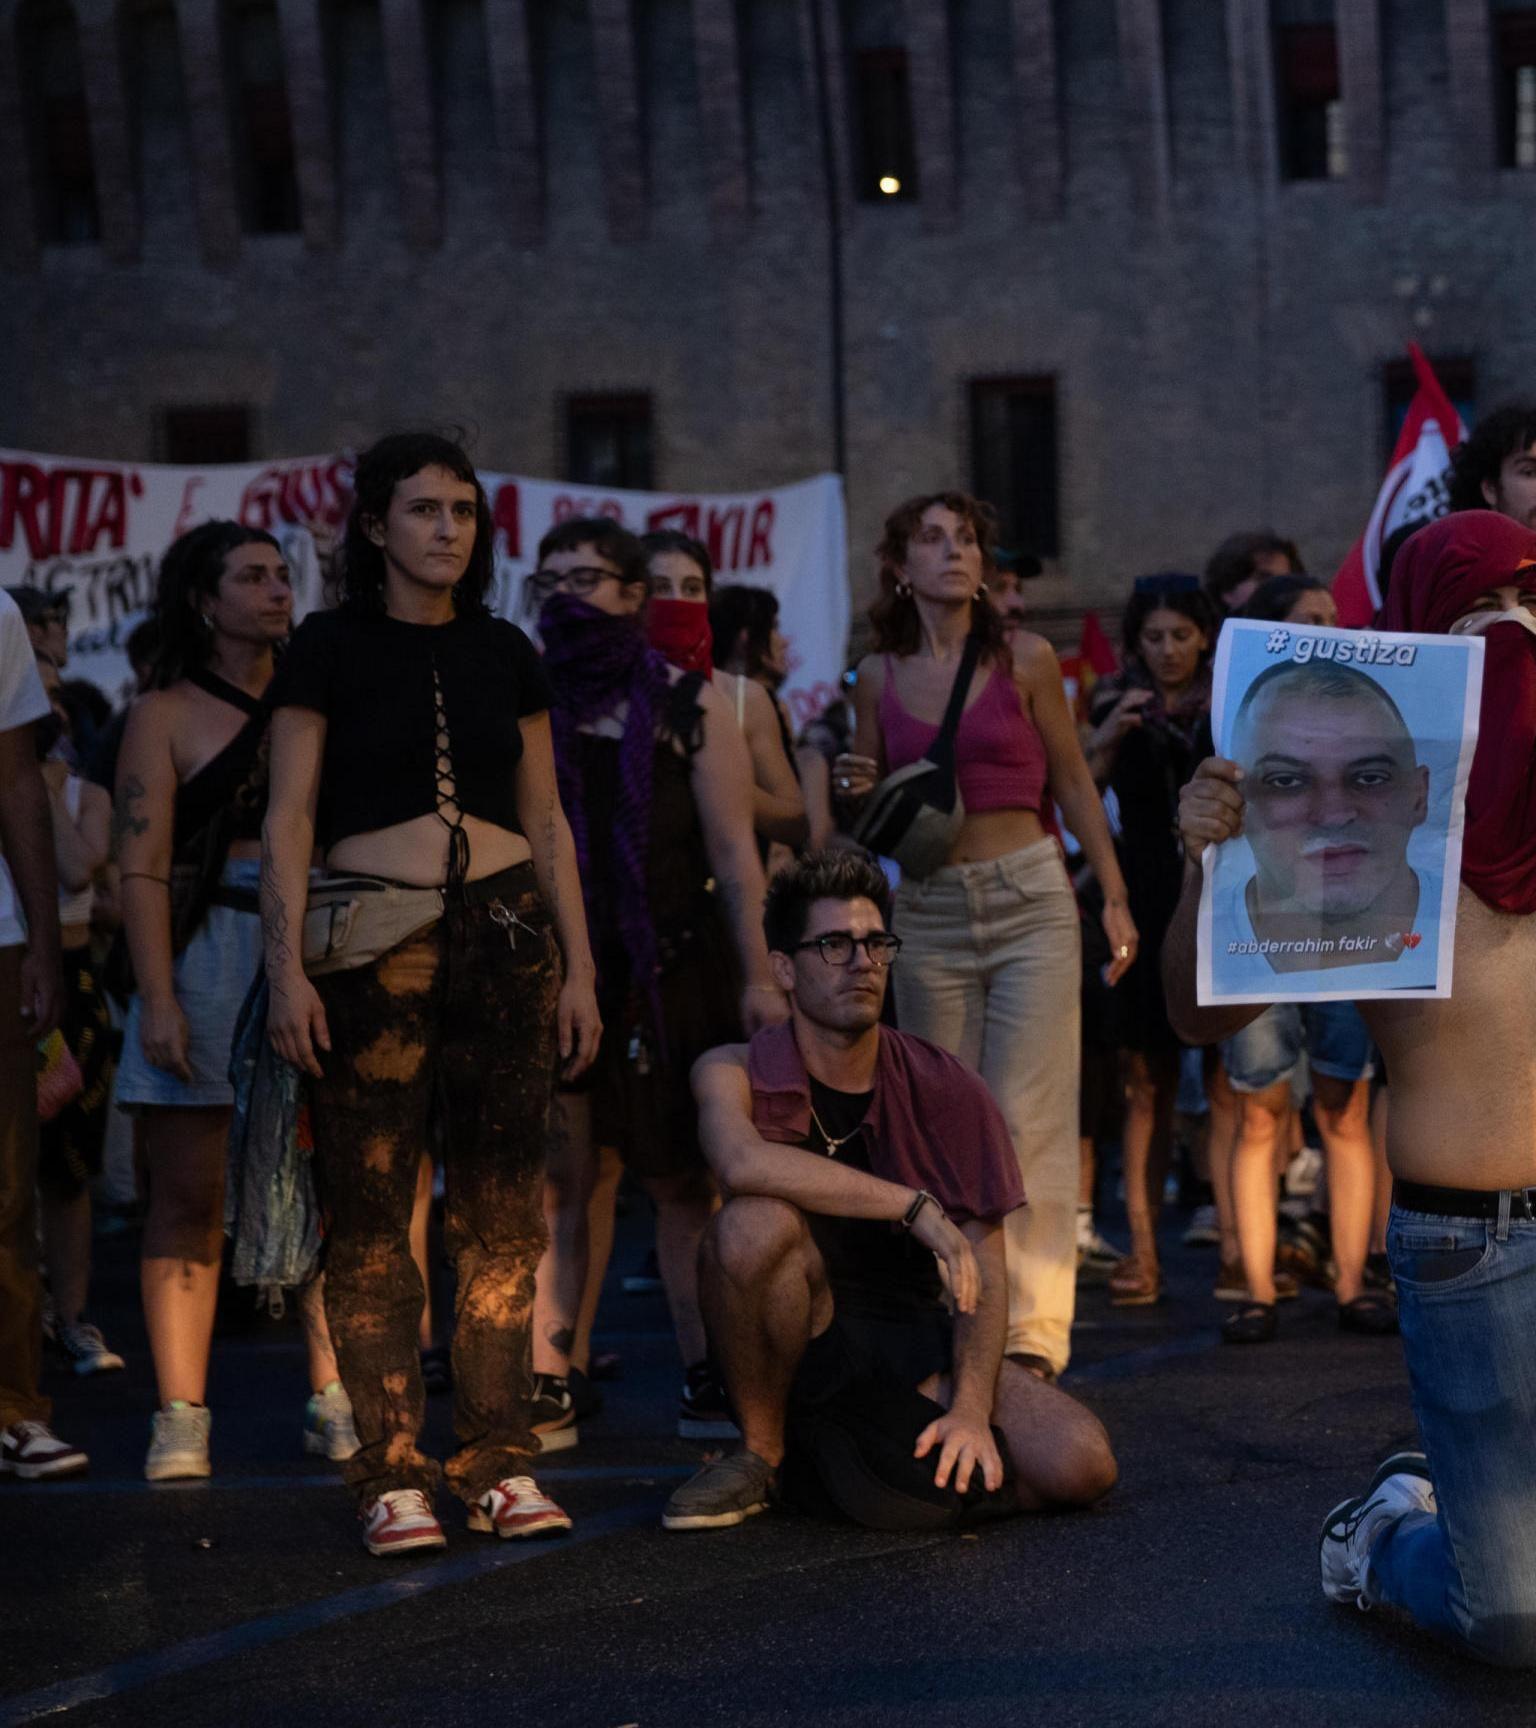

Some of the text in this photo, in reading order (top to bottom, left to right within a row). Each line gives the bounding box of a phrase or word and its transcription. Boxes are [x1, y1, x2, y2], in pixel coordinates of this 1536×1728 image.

[1292, 636, 1417, 666] gustiza
[1227, 935, 1377, 955] #abderrahim fakir
